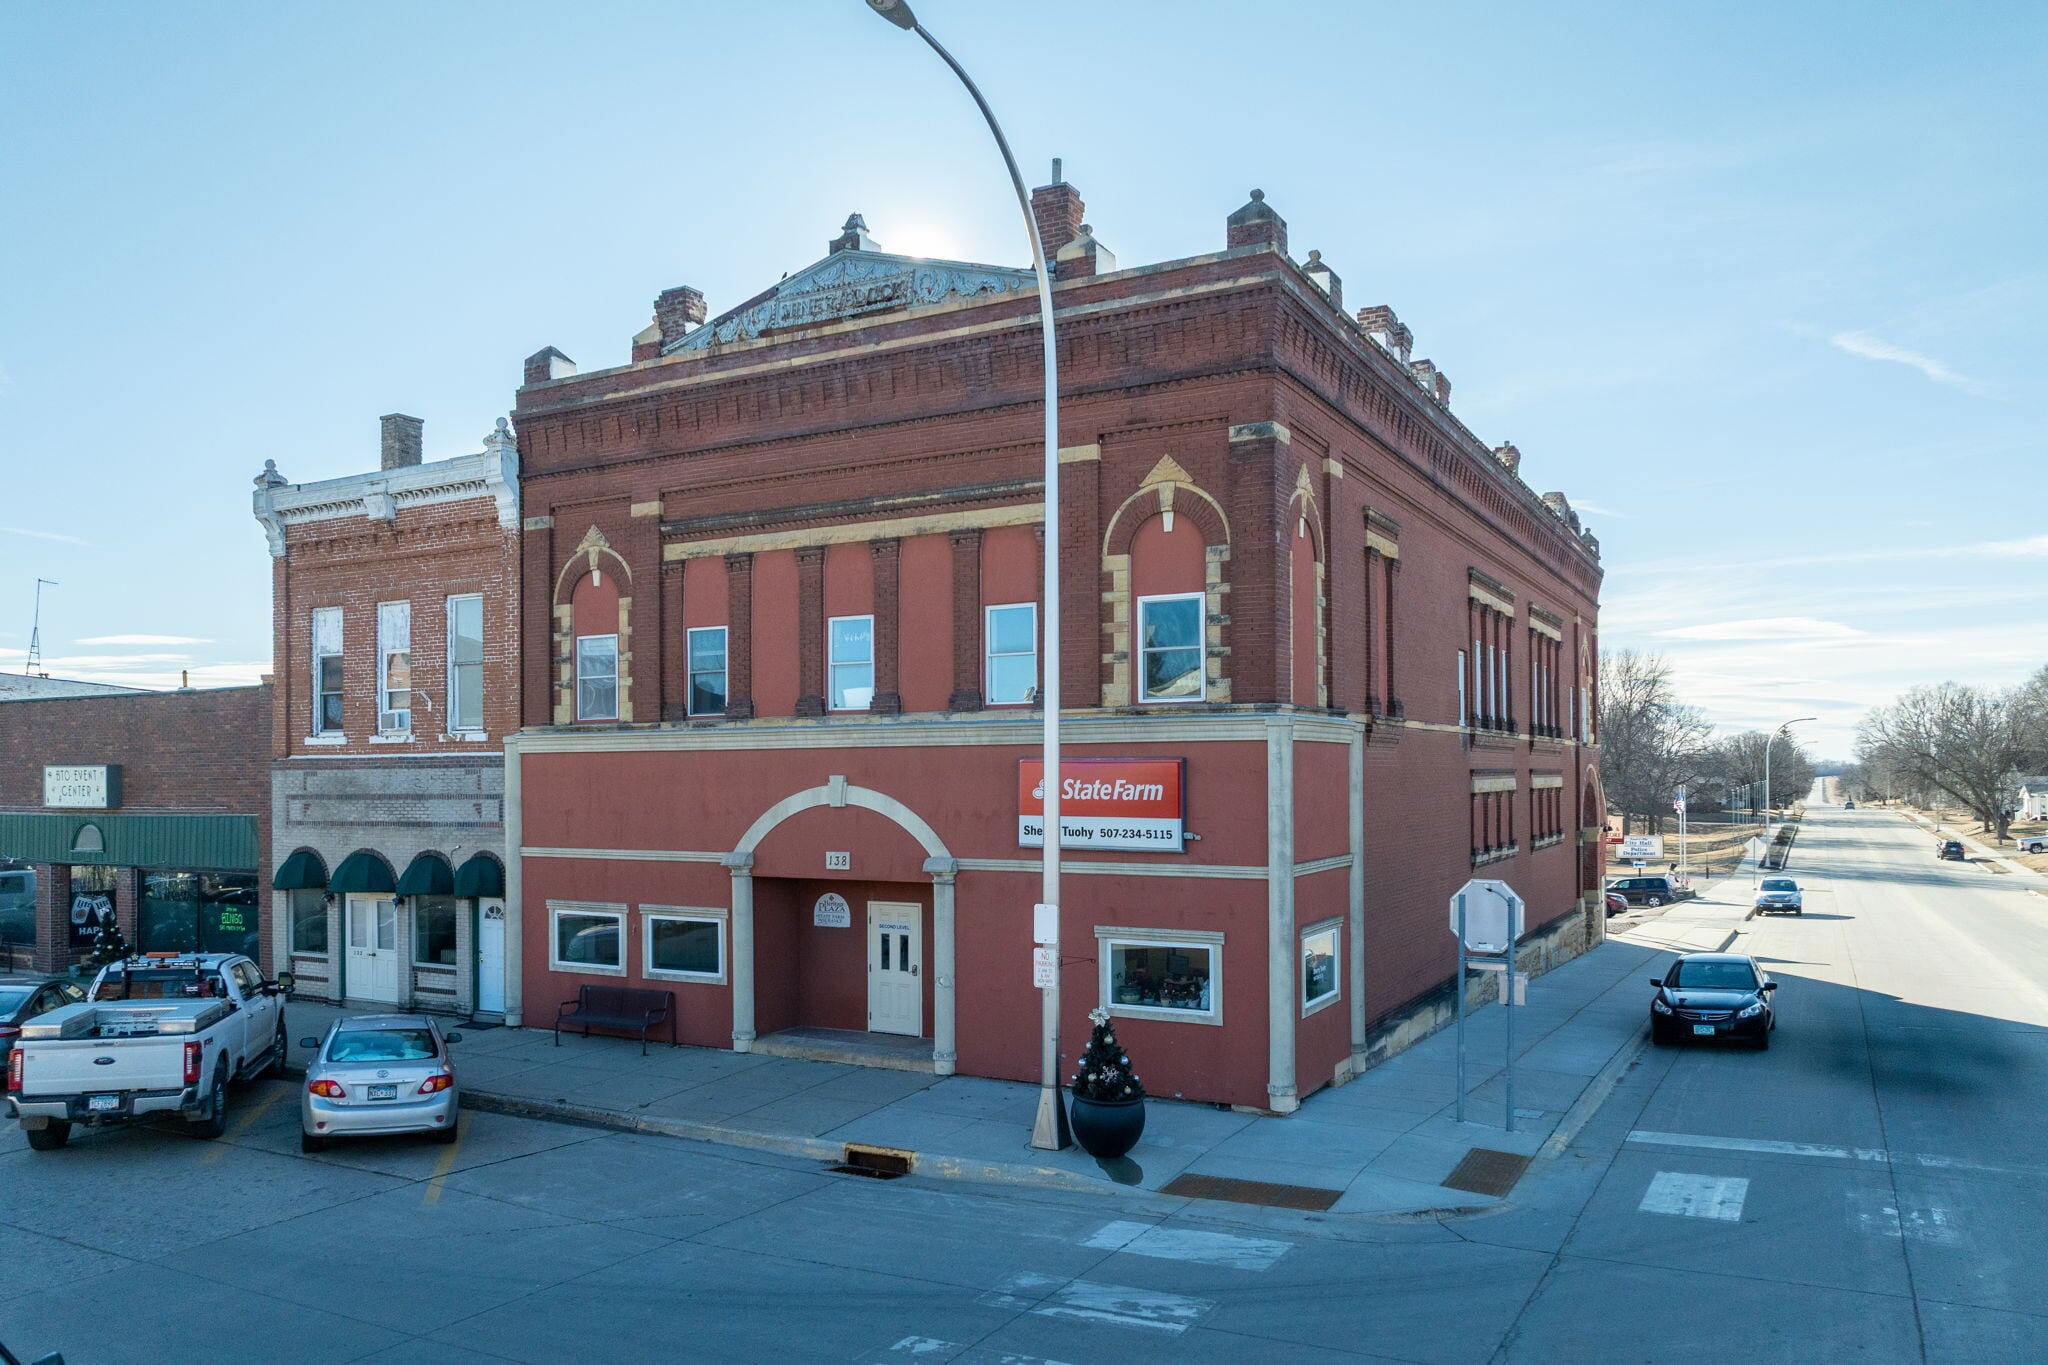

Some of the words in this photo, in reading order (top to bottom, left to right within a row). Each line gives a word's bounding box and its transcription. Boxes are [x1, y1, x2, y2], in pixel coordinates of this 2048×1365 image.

[74, 769, 97, 782] EVENT
[61, 785, 92, 798] CENTER
[1062, 826, 1094, 840] Tuohy
[1100, 828, 1173, 840] 507-234-5115
[828, 855, 848, 867] 138
[818, 902, 845, 912] PLAZA
[221, 912, 243, 924] BINGO
[79, 927, 103, 935] HAP
